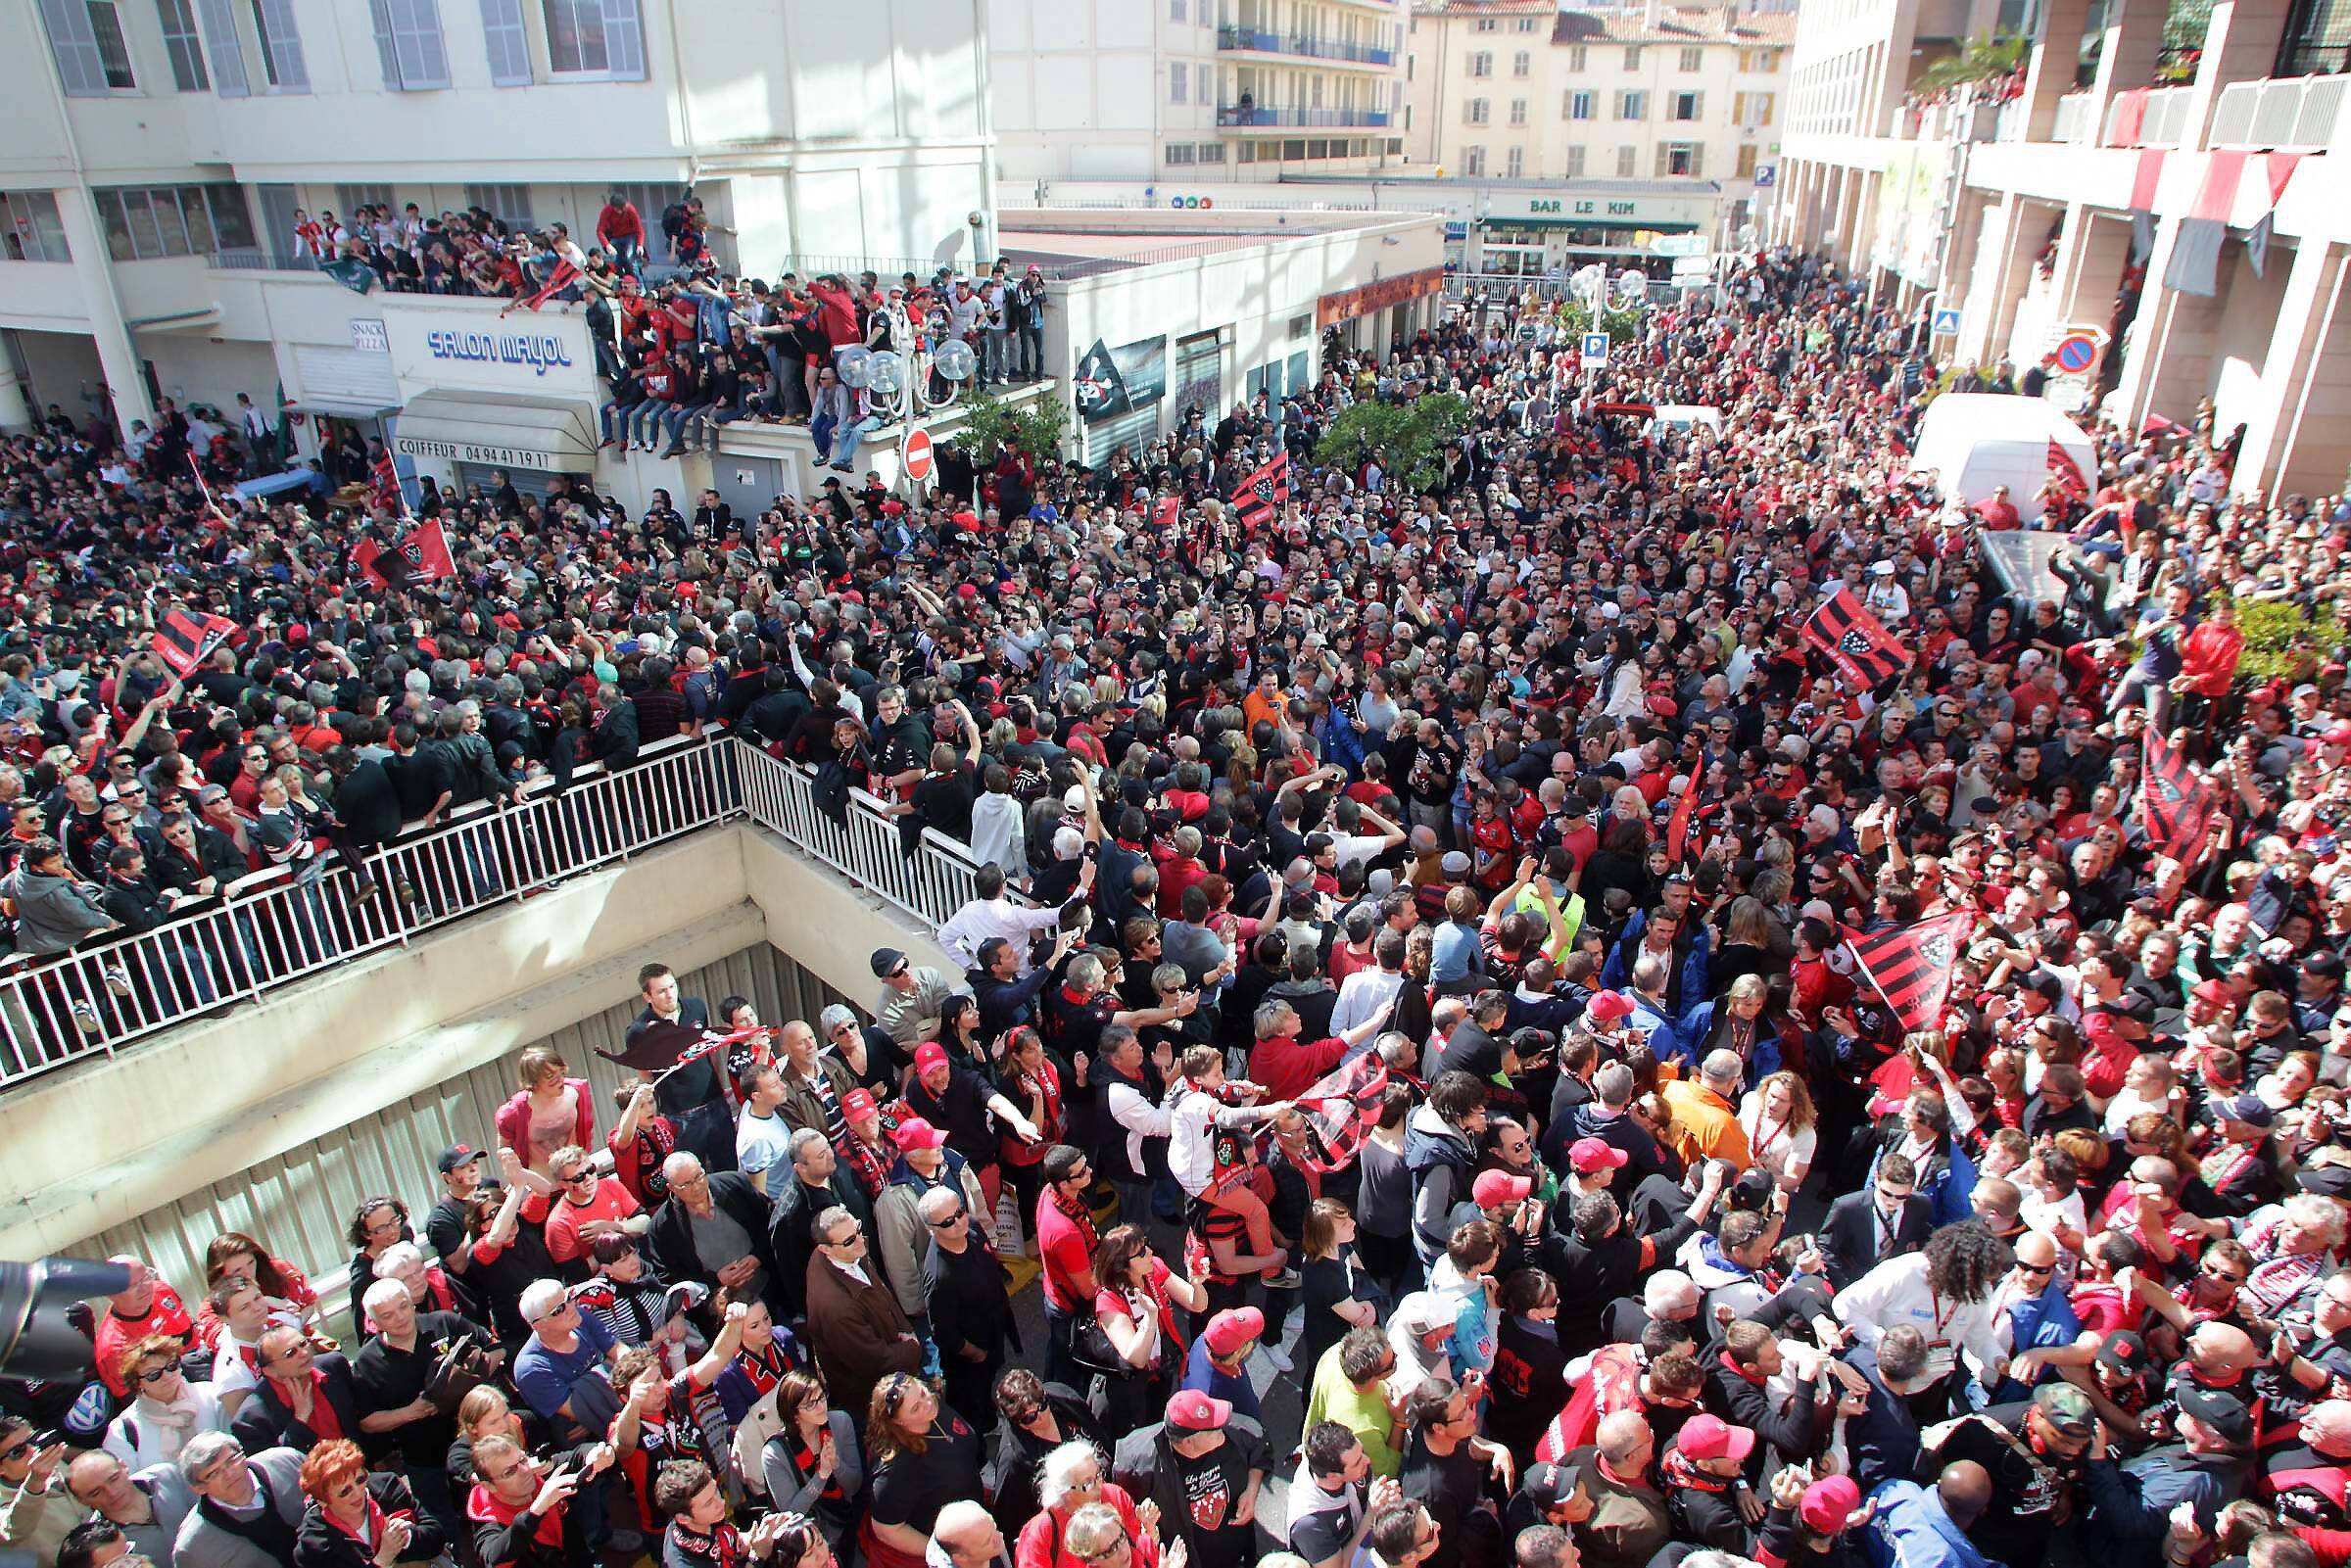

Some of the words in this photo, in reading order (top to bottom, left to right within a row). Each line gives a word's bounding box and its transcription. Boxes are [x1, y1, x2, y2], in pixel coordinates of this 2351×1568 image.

[1530, 200, 1560, 213] BAR
[1575, 201, 1594, 214] LE
[1607, 202, 1635, 214] KIM
[353, 323, 383, 336] SNACK
[354, 337, 388, 351] PIZZA
[1589, 338, 1603, 355] P
[428, 329, 498, 361] SALON
[501, 336, 572, 376] MAYOL
[400, 439, 457, 459] COIFFEUR
[465, 447, 480, 461] 04
[483, 448, 498, 462] 94
[501, 449, 514, 463] 41
[518, 451, 532, 466] 19
[538, 453, 549, 468] 11
